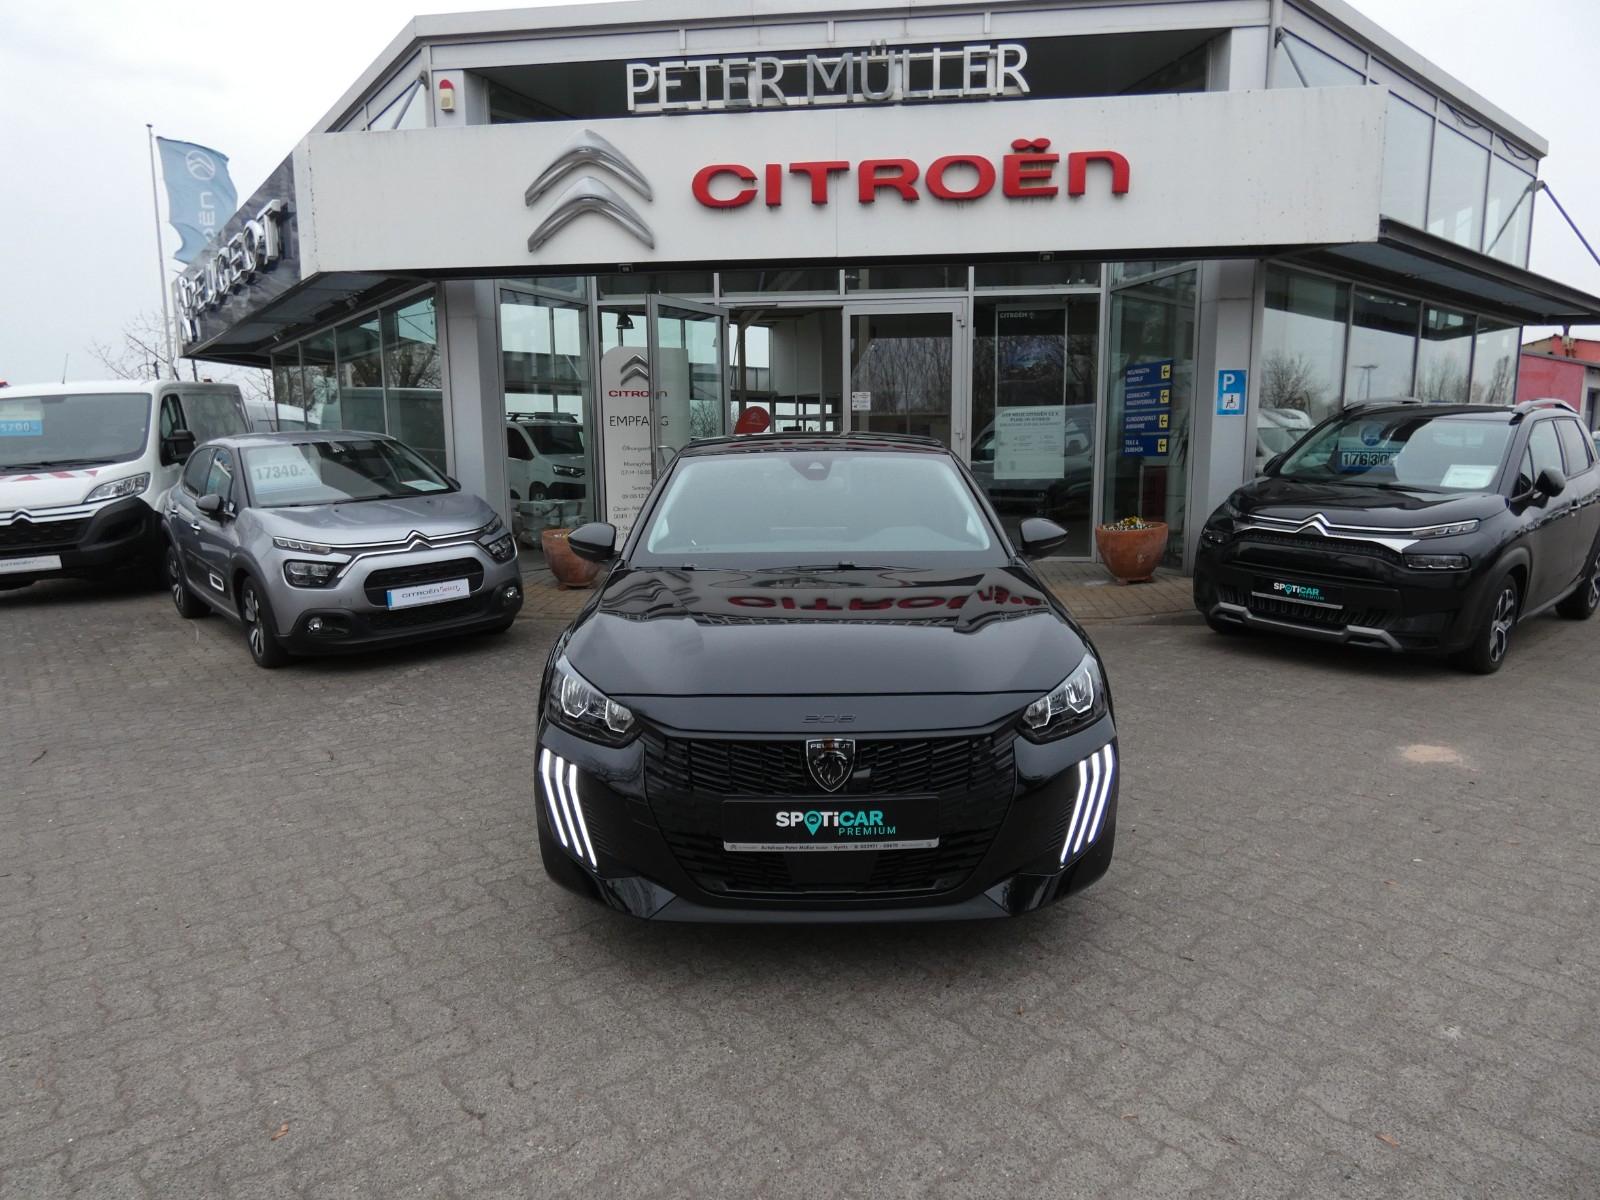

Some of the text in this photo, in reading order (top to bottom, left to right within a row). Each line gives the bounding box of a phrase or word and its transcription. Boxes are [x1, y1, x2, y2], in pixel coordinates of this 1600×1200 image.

[626, 39, 1031, 112] PETER MÜLLER
[1223, 374, 1235, 391] P
[608, 390, 668, 398] CITRON
[609, 416, 669, 428] EMPFAG
[838, 825, 897, 836] PREMIUM
